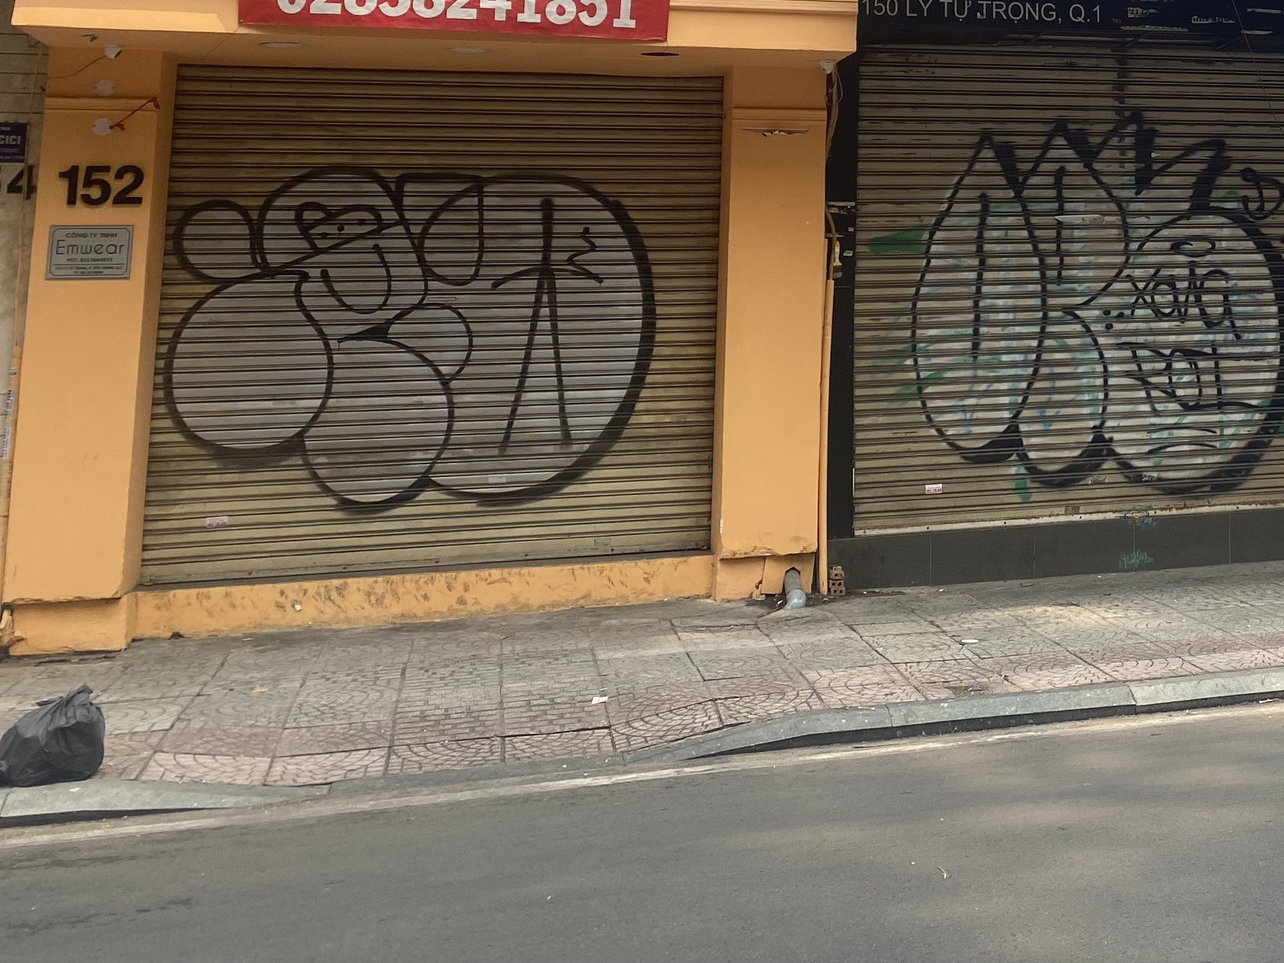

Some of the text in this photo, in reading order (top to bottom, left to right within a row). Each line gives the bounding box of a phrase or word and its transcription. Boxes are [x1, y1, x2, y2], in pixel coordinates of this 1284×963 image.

[939, 0, 973, 22] TỰ
[977, 1, 1062, 24] TRỌNG,
[1069, 4, 1101, 23] Q.1
[58, 165, 144, 206] 152
[55, 239, 125, 255] Emwear
